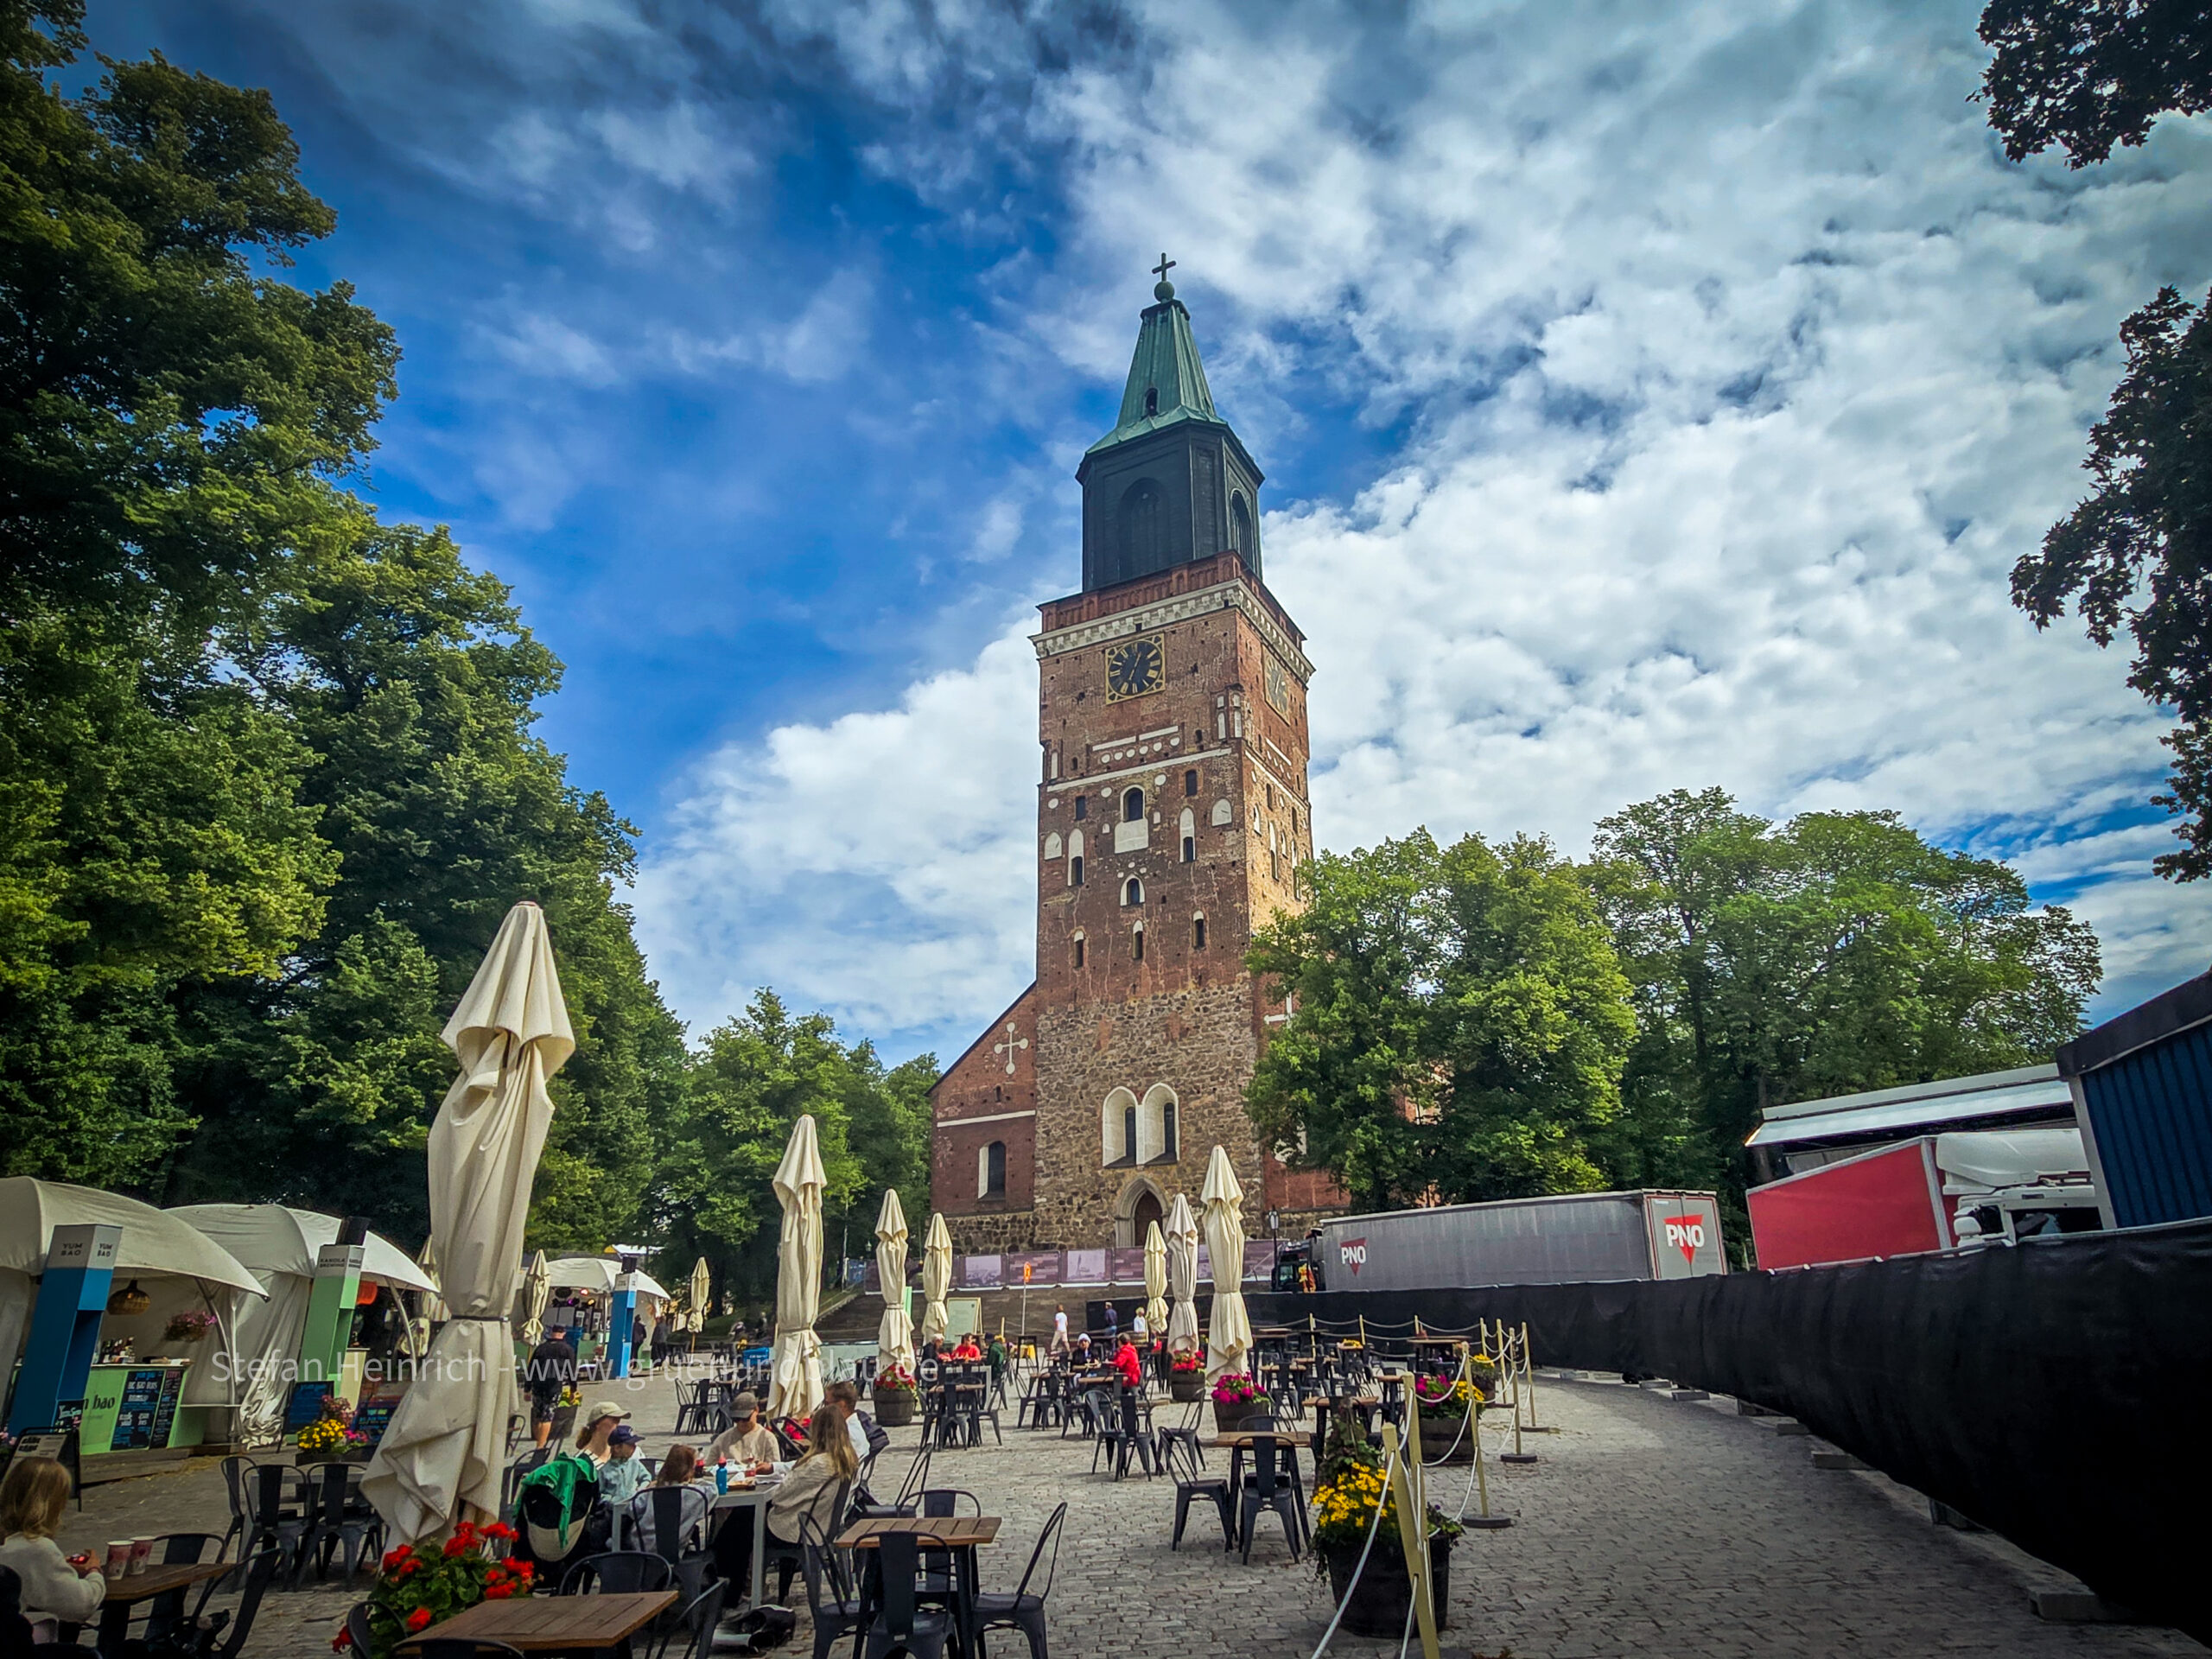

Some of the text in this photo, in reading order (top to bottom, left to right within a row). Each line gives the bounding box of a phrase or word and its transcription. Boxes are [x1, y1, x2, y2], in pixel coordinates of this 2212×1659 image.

[1665, 1224, 1705, 1248] PNO
[97, 1249, 111, 1258] BAO
[1341, 1245, 1367, 1264] PNO
[92, 1394, 116, 1410] bao
